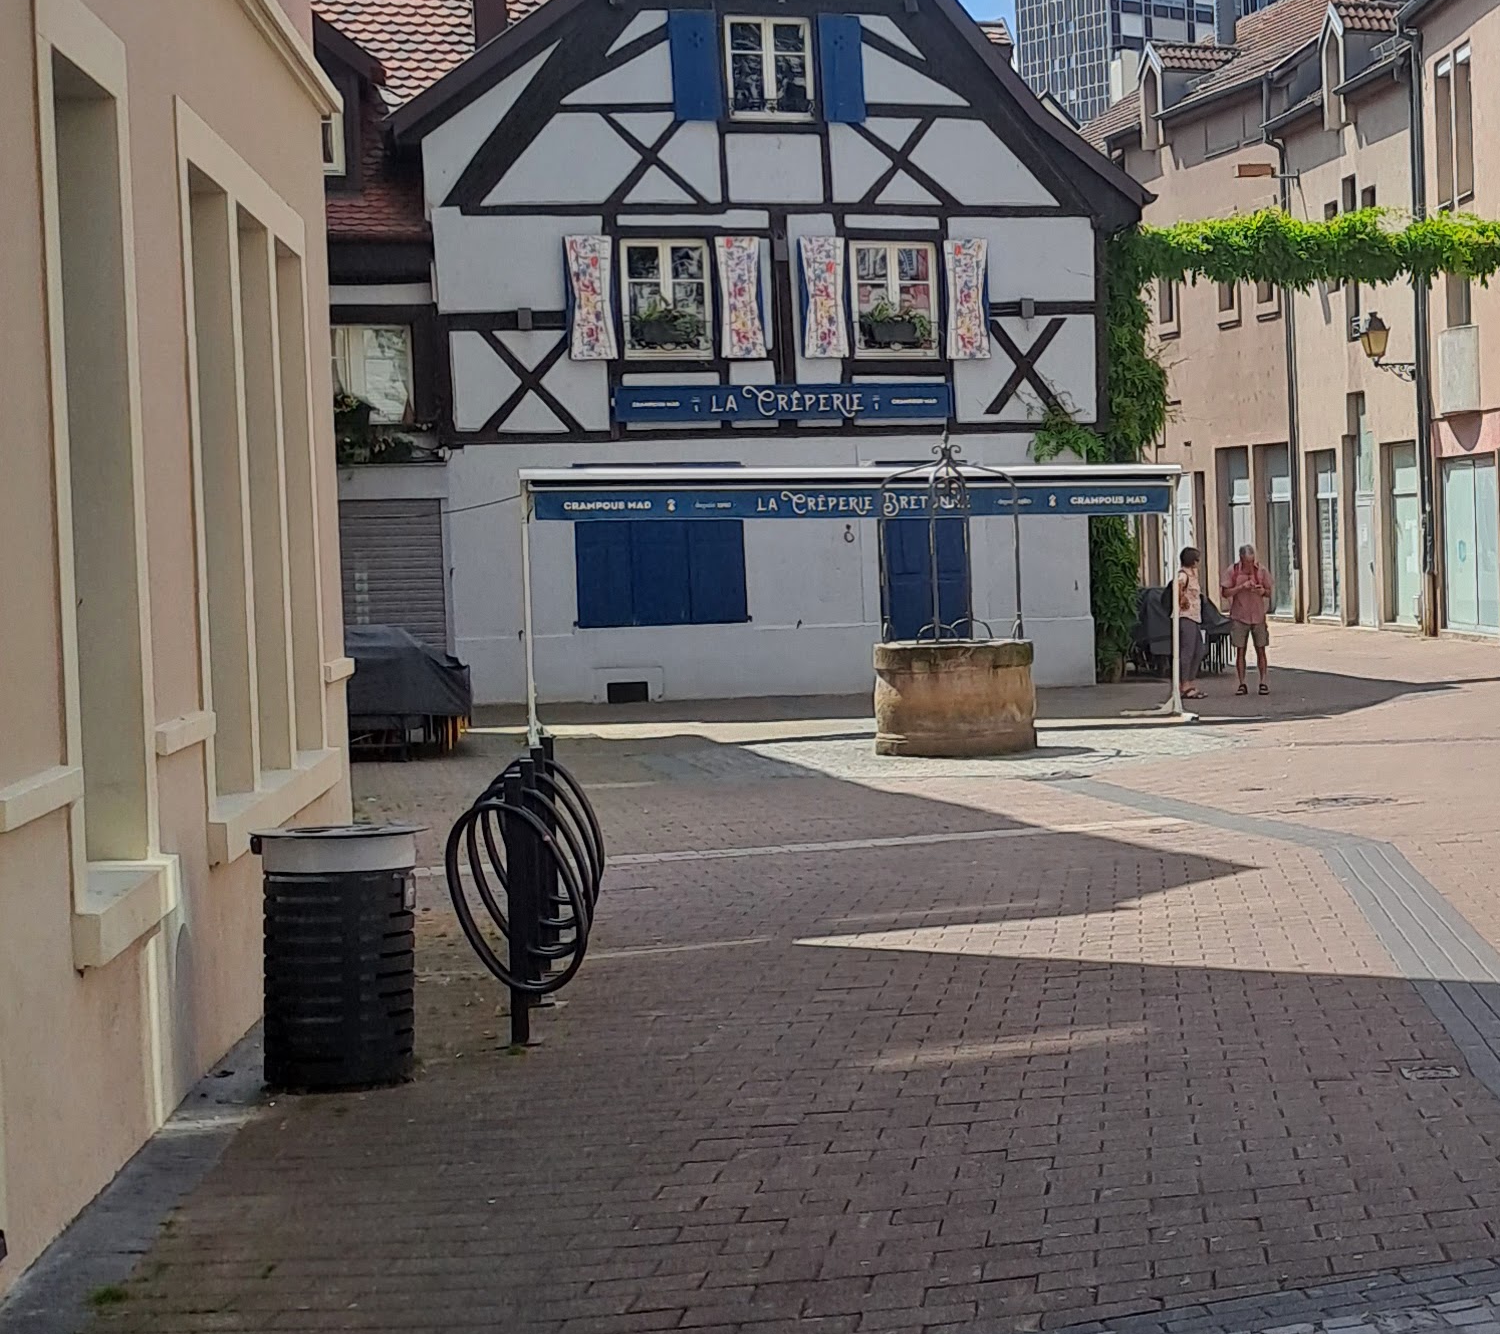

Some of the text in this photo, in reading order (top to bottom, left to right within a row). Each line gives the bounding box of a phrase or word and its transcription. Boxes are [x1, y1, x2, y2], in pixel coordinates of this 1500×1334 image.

[711, 395, 738, 412] LA
[563, 500, 625, 510] CRAMPOUS
[757, 497, 778, 512] LA
